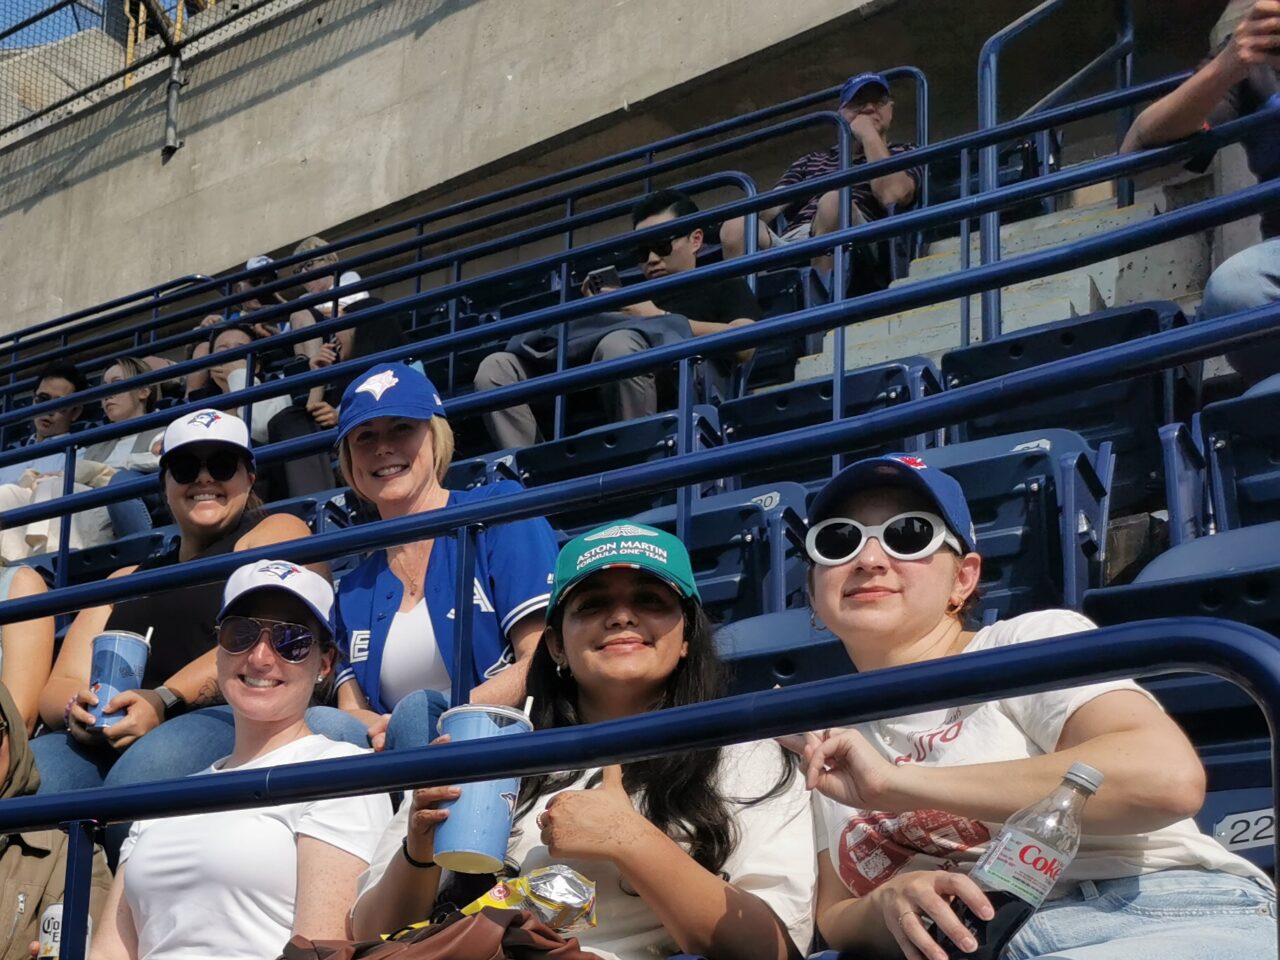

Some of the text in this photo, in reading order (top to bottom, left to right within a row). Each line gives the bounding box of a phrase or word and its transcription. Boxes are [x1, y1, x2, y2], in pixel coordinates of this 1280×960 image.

[576, 541, 668, 564] ASTON MARTIN
[576, 550, 618, 571] FORMULA
[644, 551, 667, 564] TEAM
[1228, 815, 1274, 845] 22
